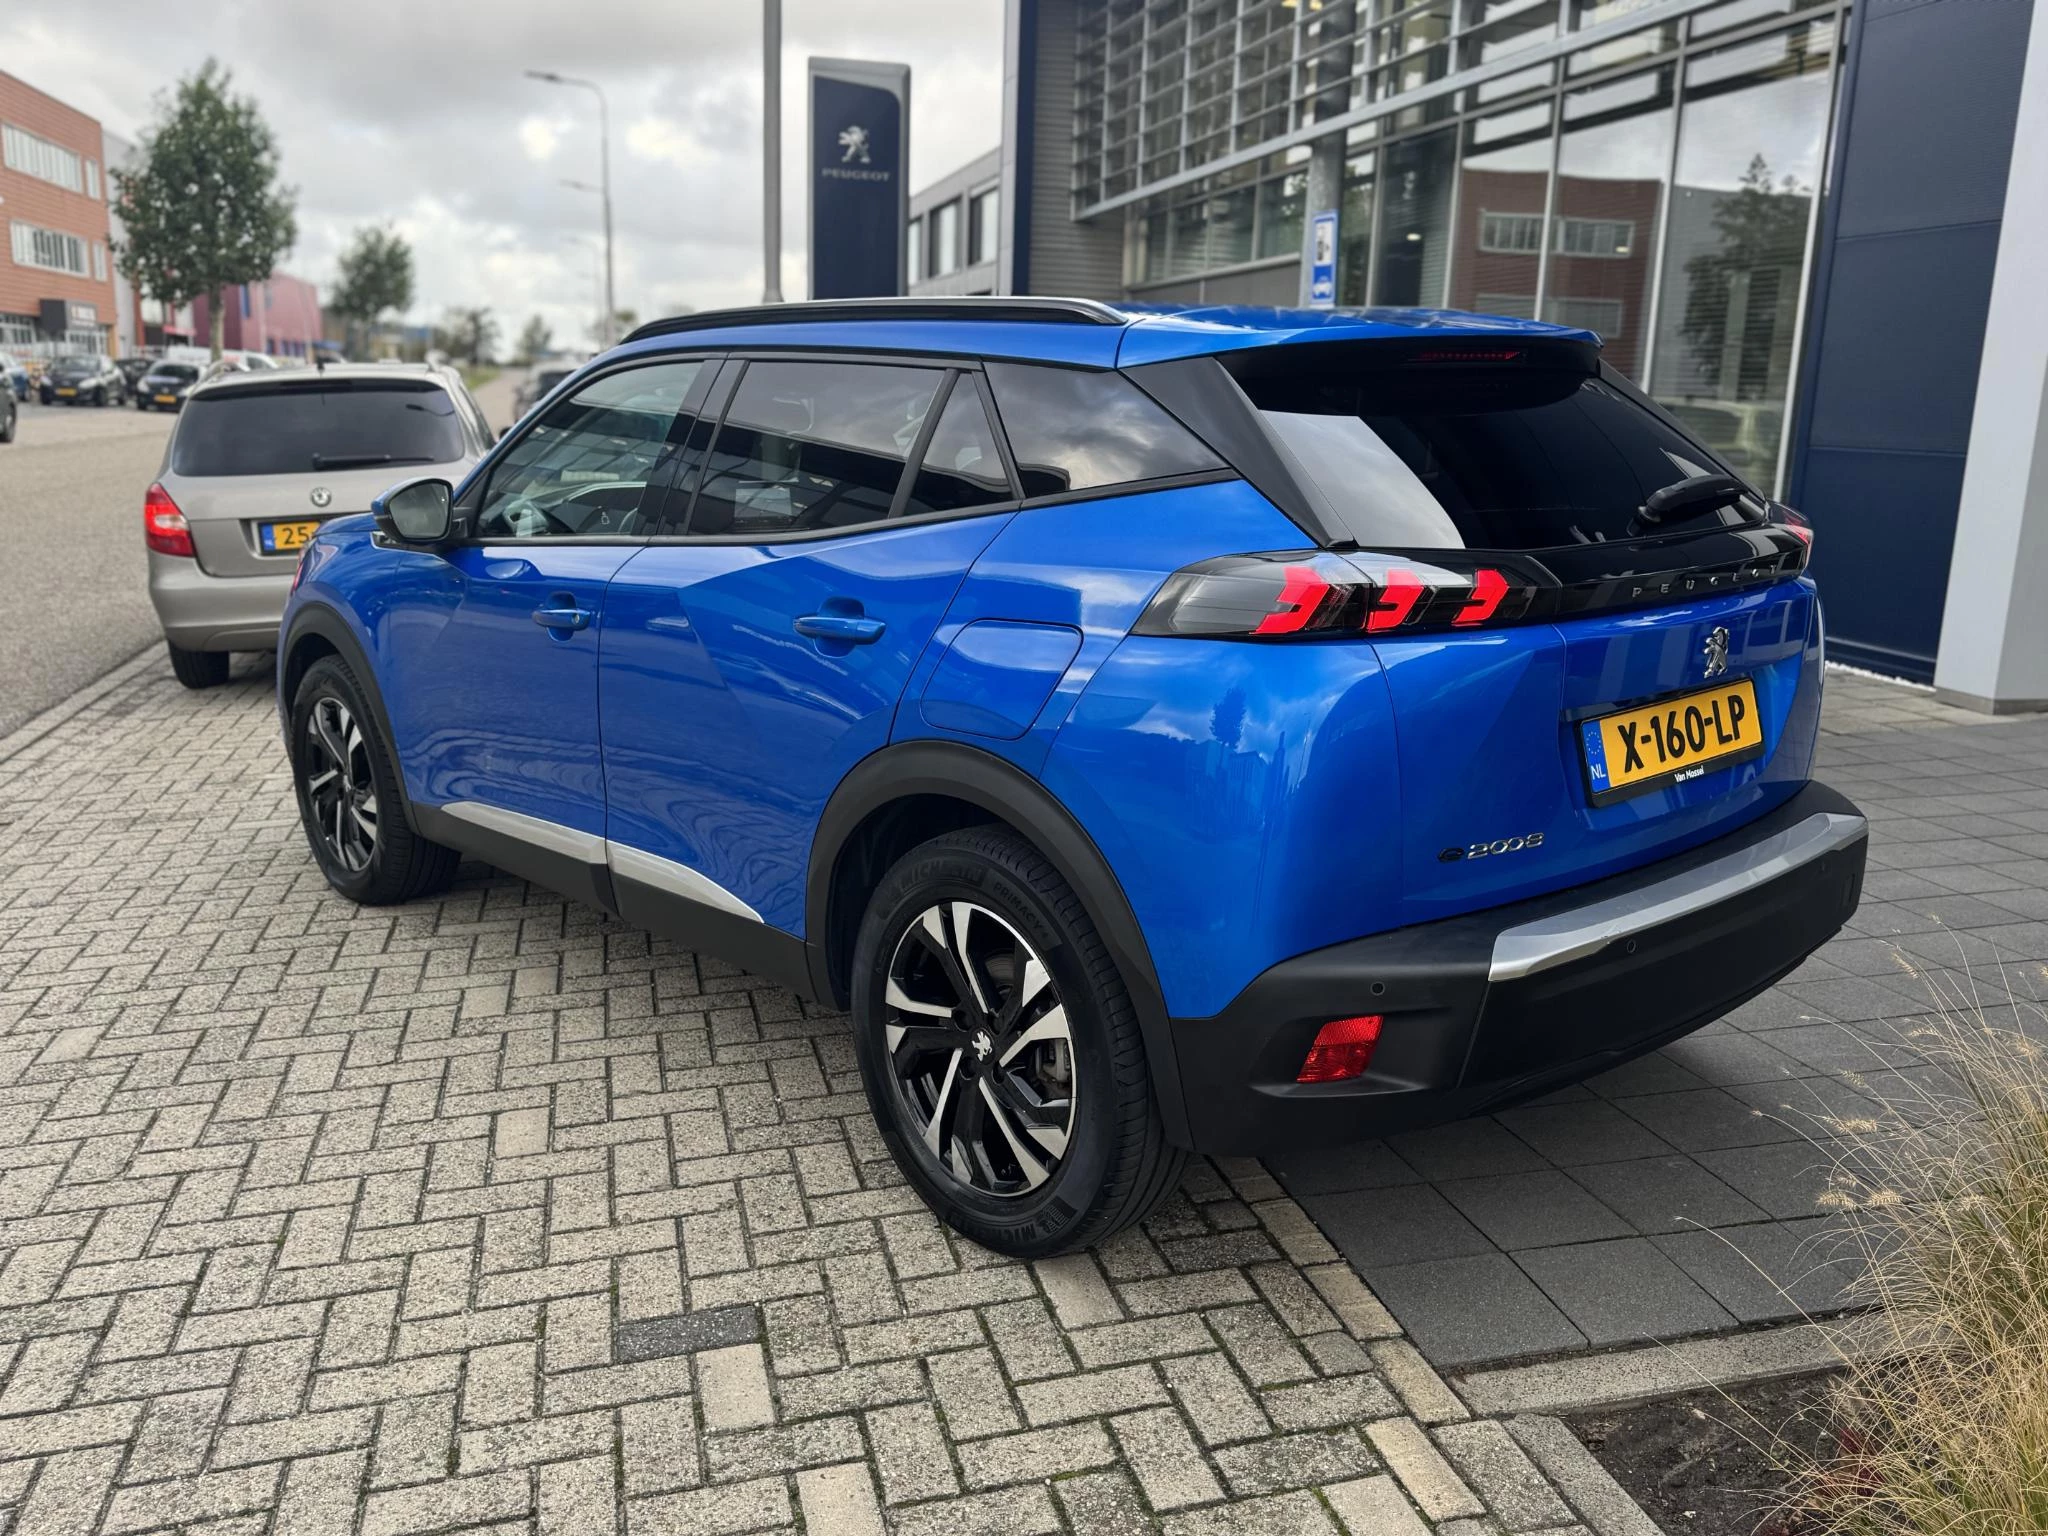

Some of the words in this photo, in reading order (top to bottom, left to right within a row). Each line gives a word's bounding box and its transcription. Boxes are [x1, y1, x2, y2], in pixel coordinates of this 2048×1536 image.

[821, 168, 890, 181] PEUGEOT
[1632, 564, 1777, 598] PEUGEOT
[1617, 694, 1745, 773] X-160-LP
[1590, 763, 1607, 781] NL
[1674, 772, 1687, 784] Van
[992, 881, 1043, 929] PRIMACY
